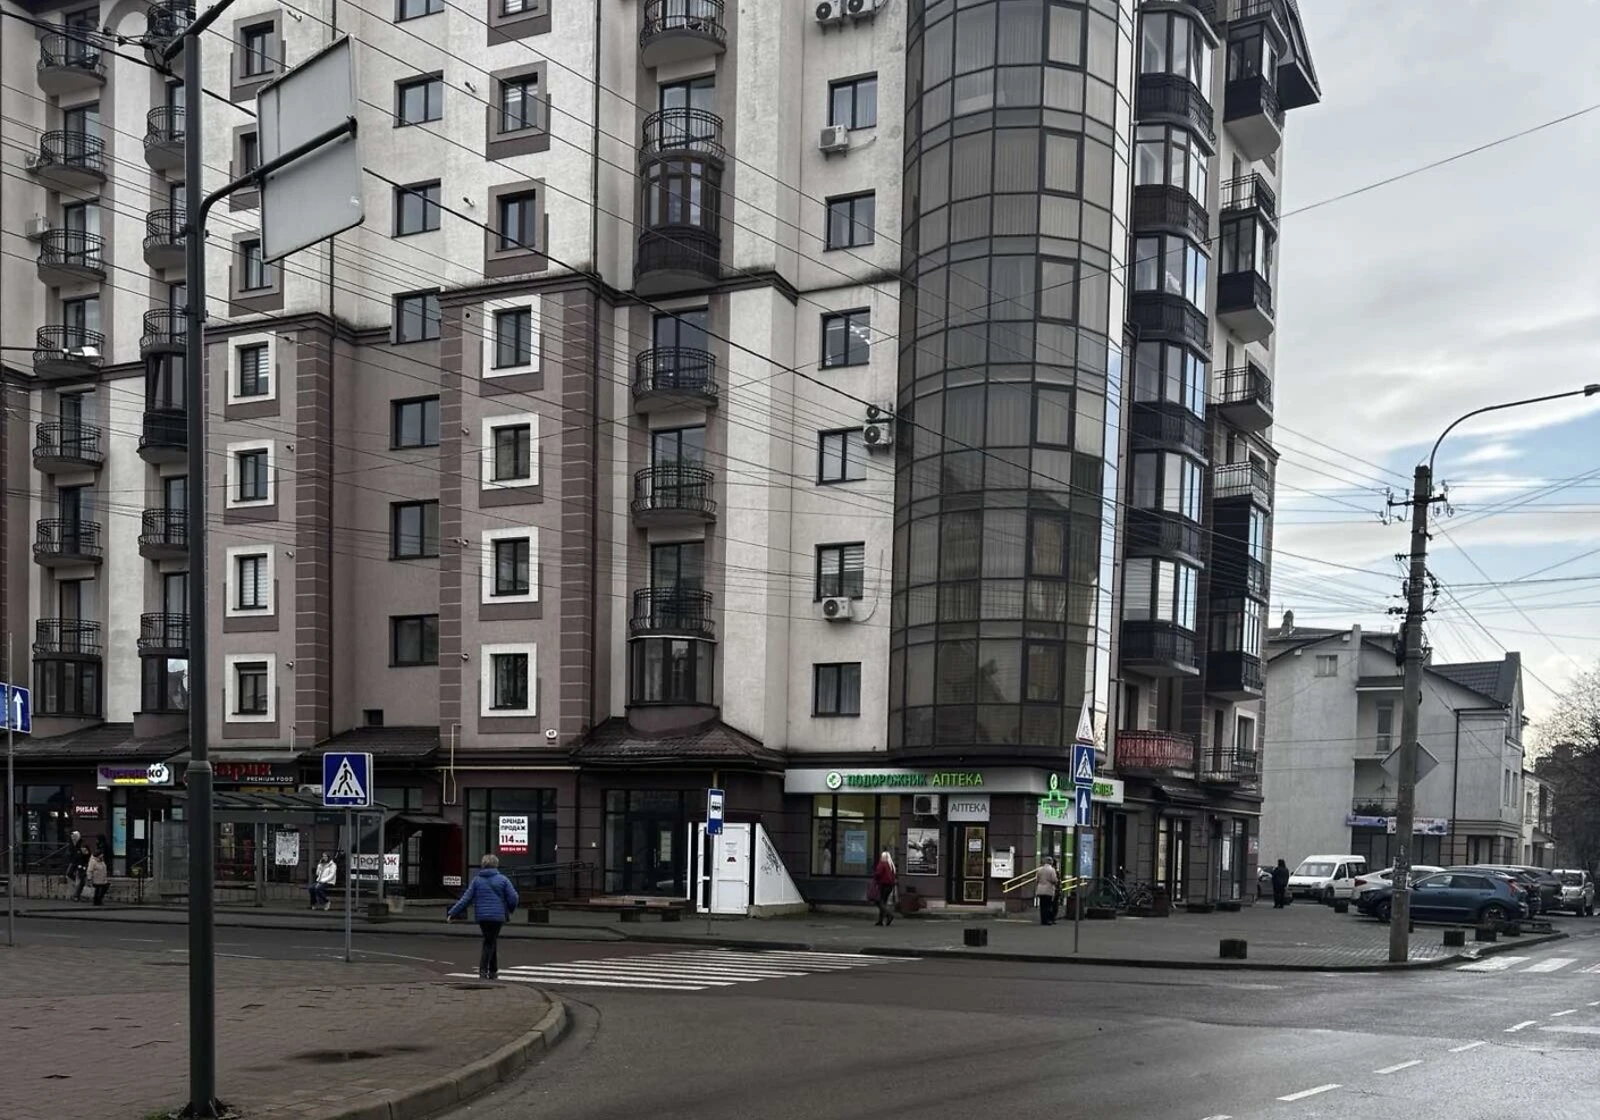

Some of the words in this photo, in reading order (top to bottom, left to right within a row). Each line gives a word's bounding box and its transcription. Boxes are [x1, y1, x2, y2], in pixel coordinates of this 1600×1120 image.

[847, 773, 927, 788] ПОДОРОЖНИК
[932, 772, 984, 788] АПТЕКА
[951, 802, 987, 813] АПТЕКА
[501, 834, 515, 843] 114
